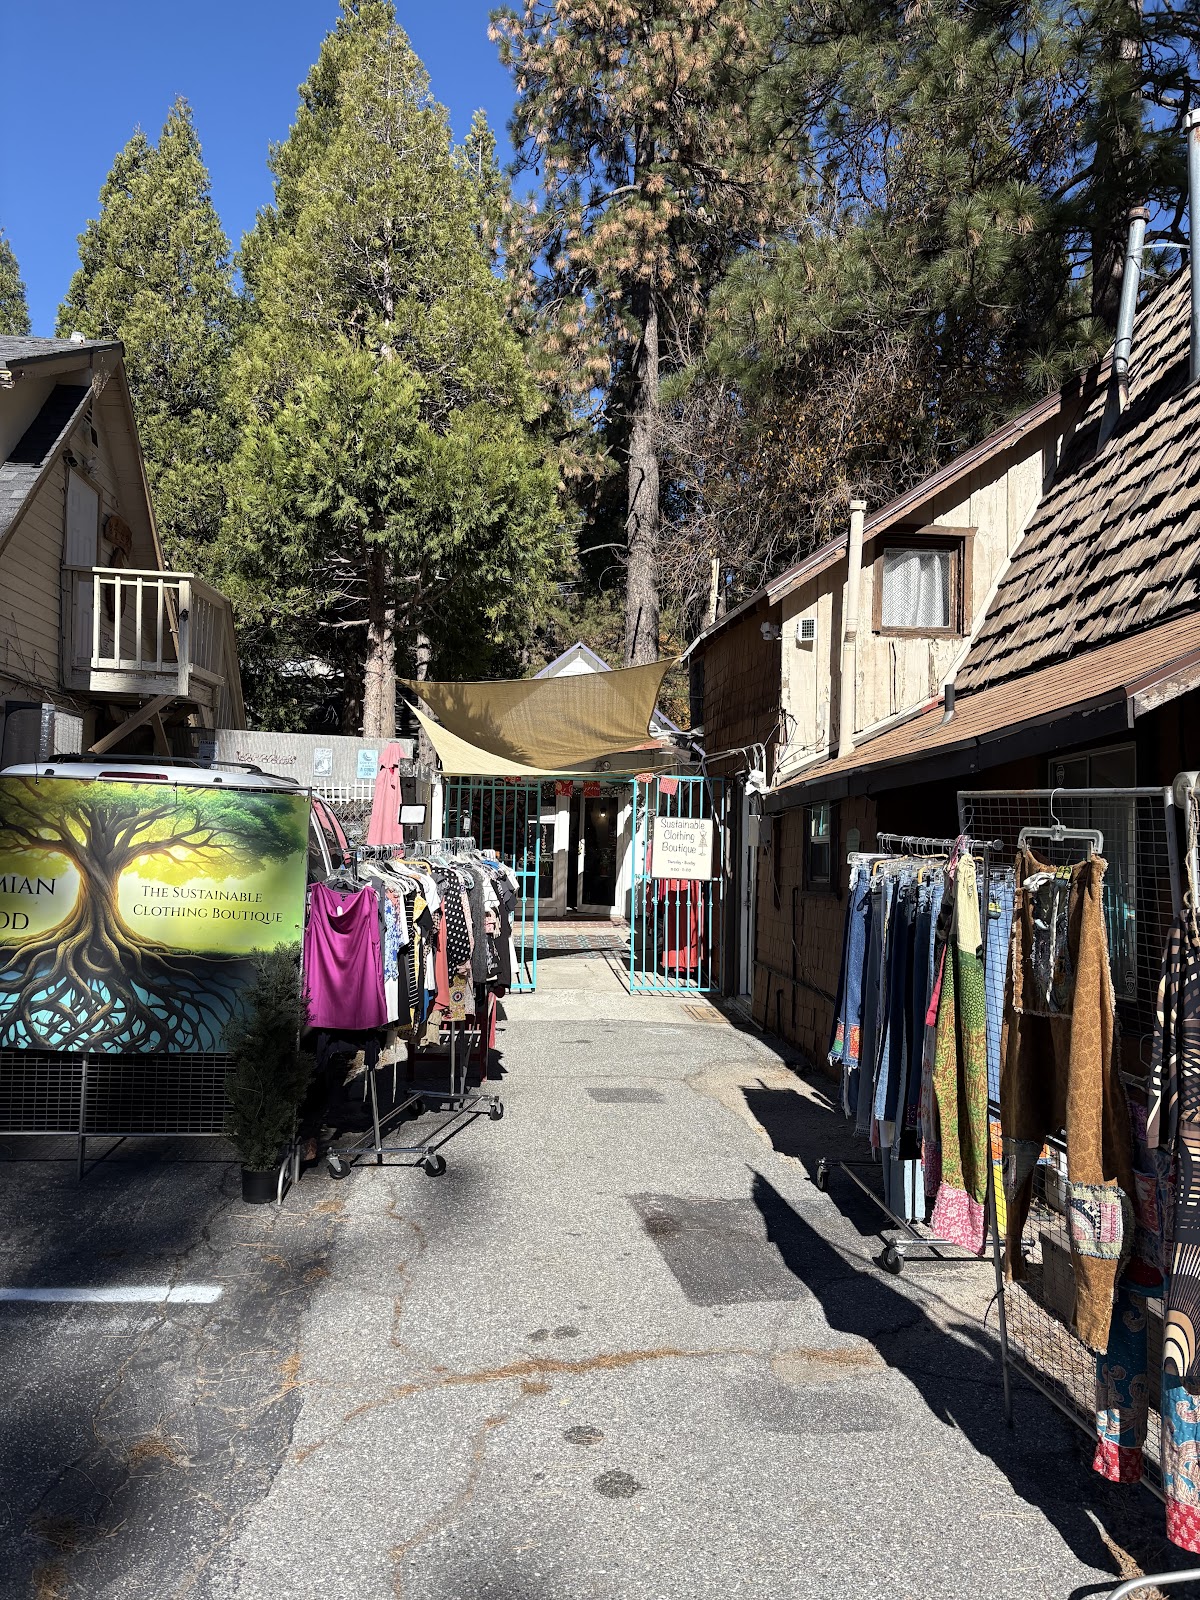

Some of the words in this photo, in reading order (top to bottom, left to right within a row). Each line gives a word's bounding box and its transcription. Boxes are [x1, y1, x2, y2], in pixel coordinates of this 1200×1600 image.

[660, 818, 705, 830] Sustainable
[663, 829, 696, 843] Clothing
[661, 841, 697, 856] Boutique
[141, 885, 169, 898] THE
[172, 886, 263, 903] SUSTAINABLE
[133, 903, 208, 918] CLOTHING
[212, 907, 283, 925] BOUTIQUE
